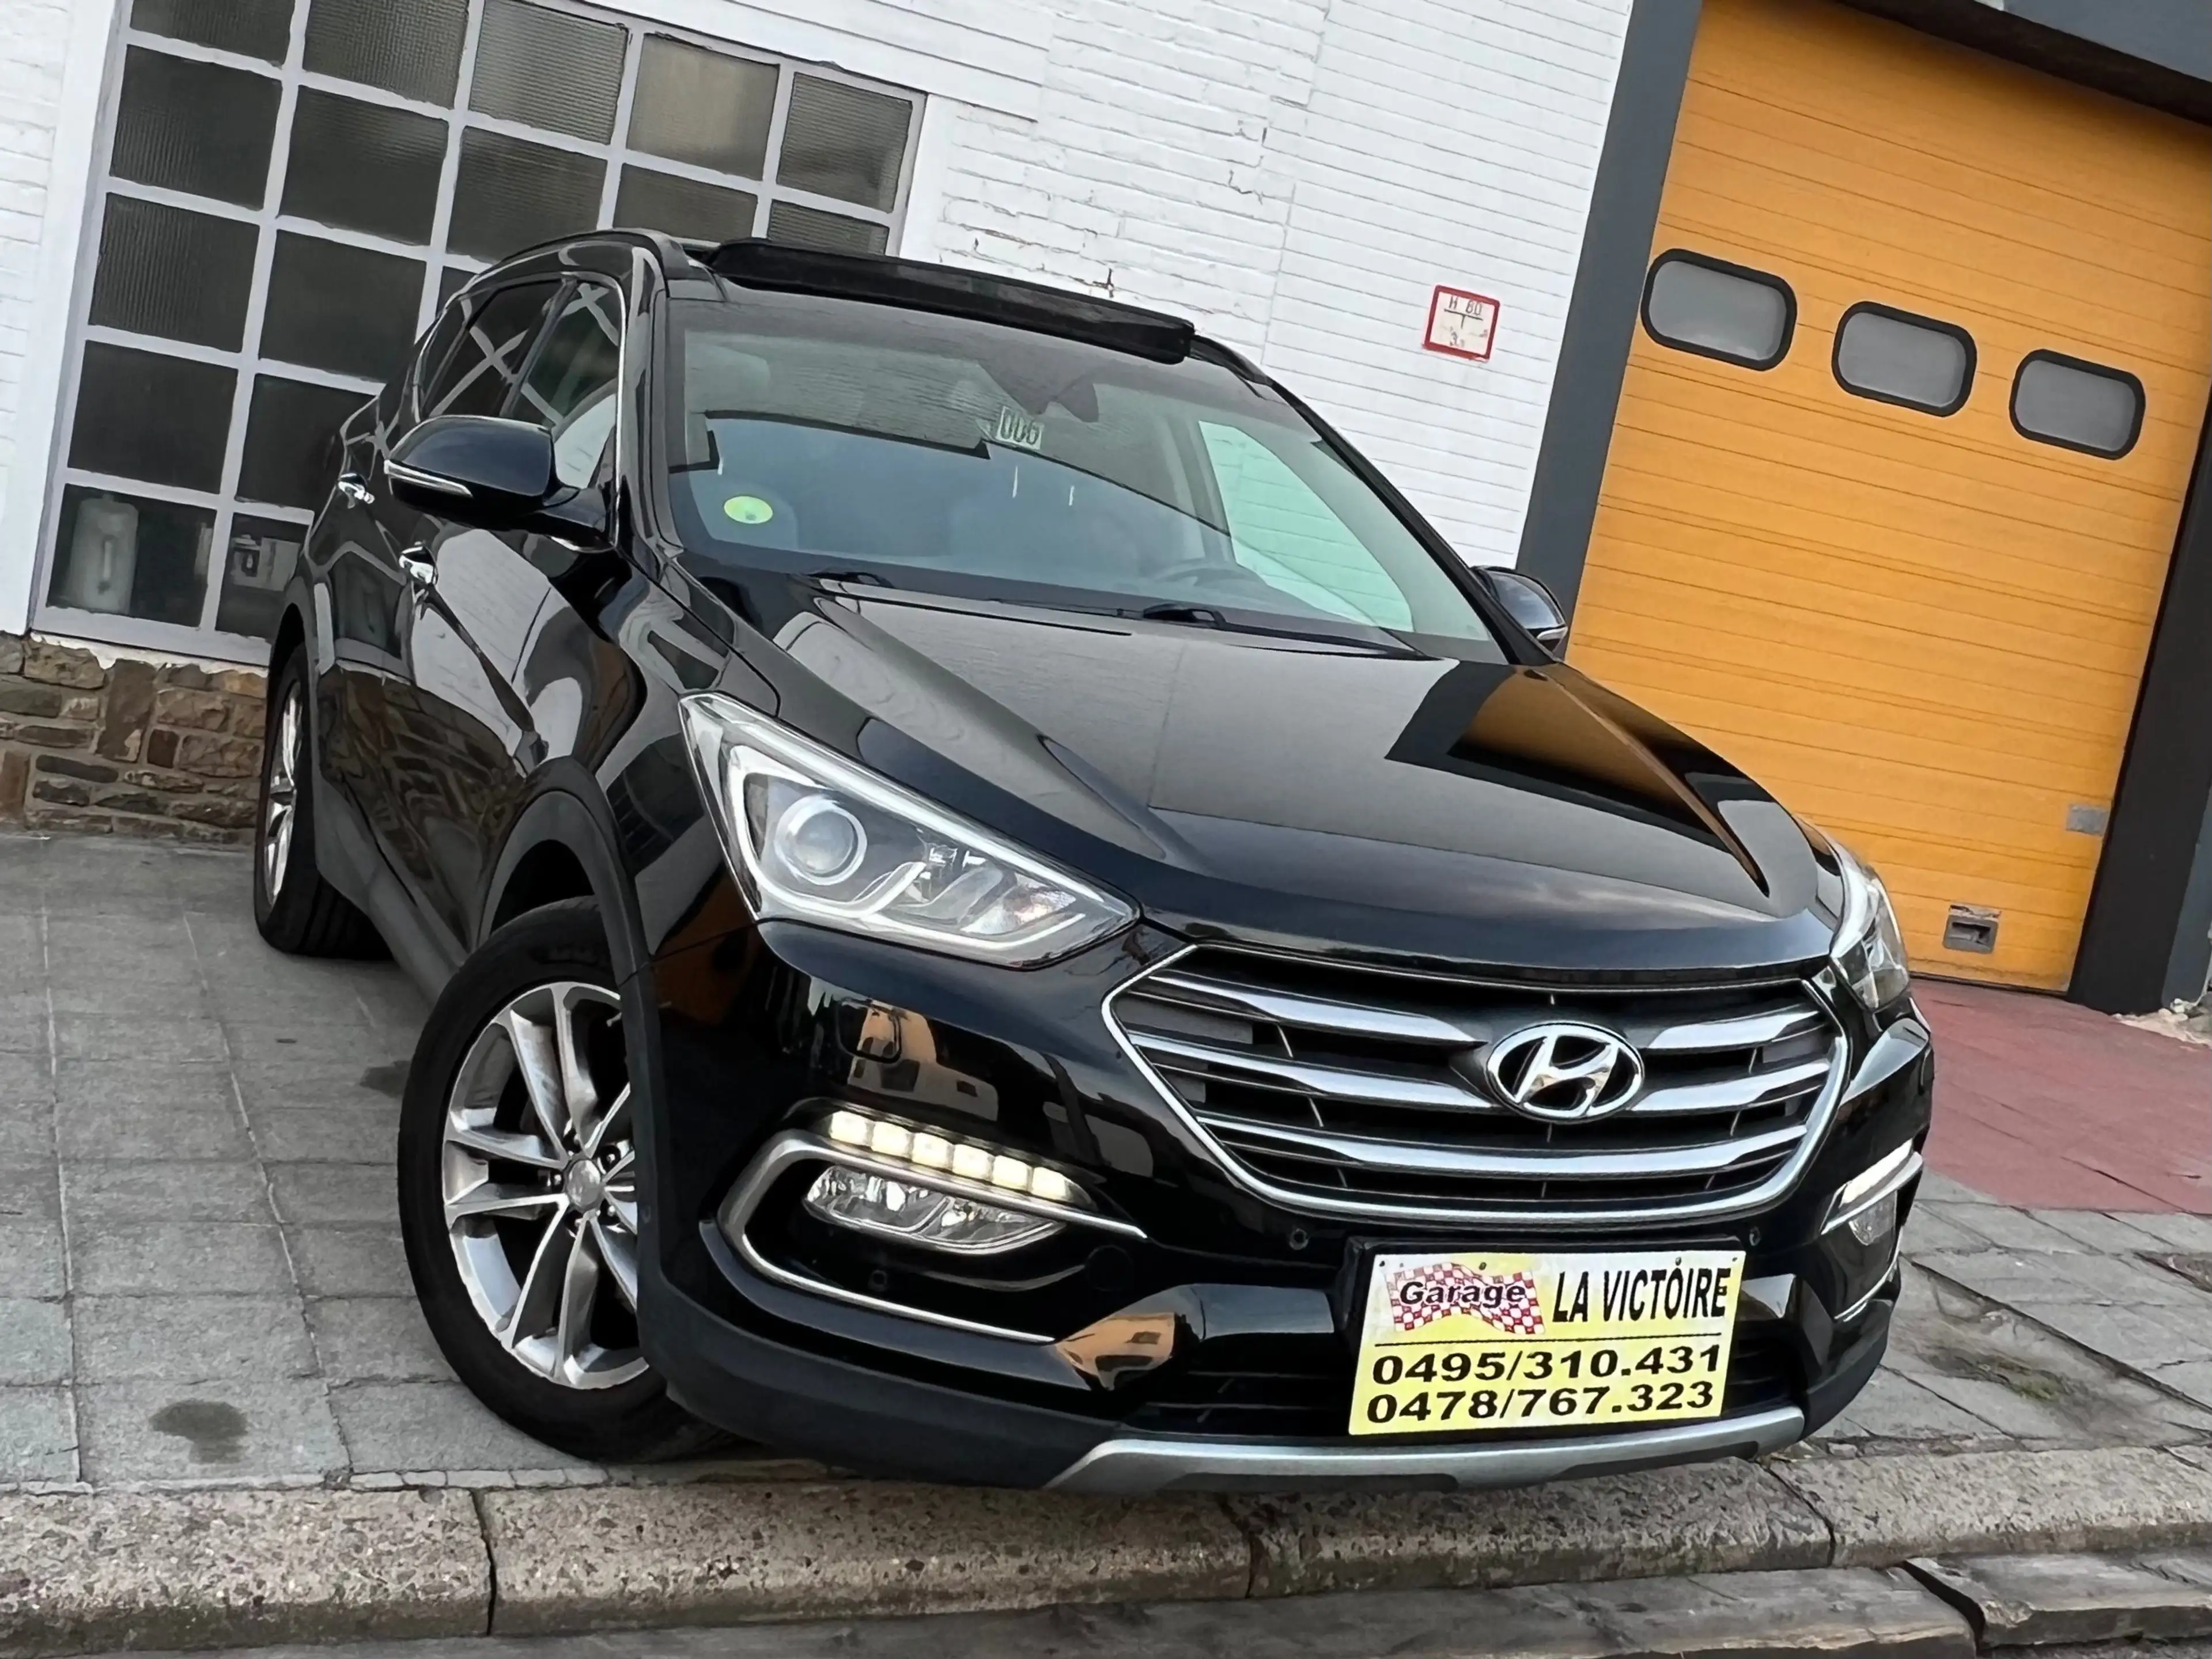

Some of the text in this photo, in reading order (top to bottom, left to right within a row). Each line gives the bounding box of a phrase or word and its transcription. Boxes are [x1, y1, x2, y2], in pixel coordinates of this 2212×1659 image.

[1449, 294, 1459, 309] H
[1400, 1281, 1526, 1309] Garage
[1552, 1267, 1731, 1322] LA VICTOIRE
[1372, 1344, 1719, 1384] 0495/310.431
[1367, 1381, 1713, 1423] 0478/767.323
